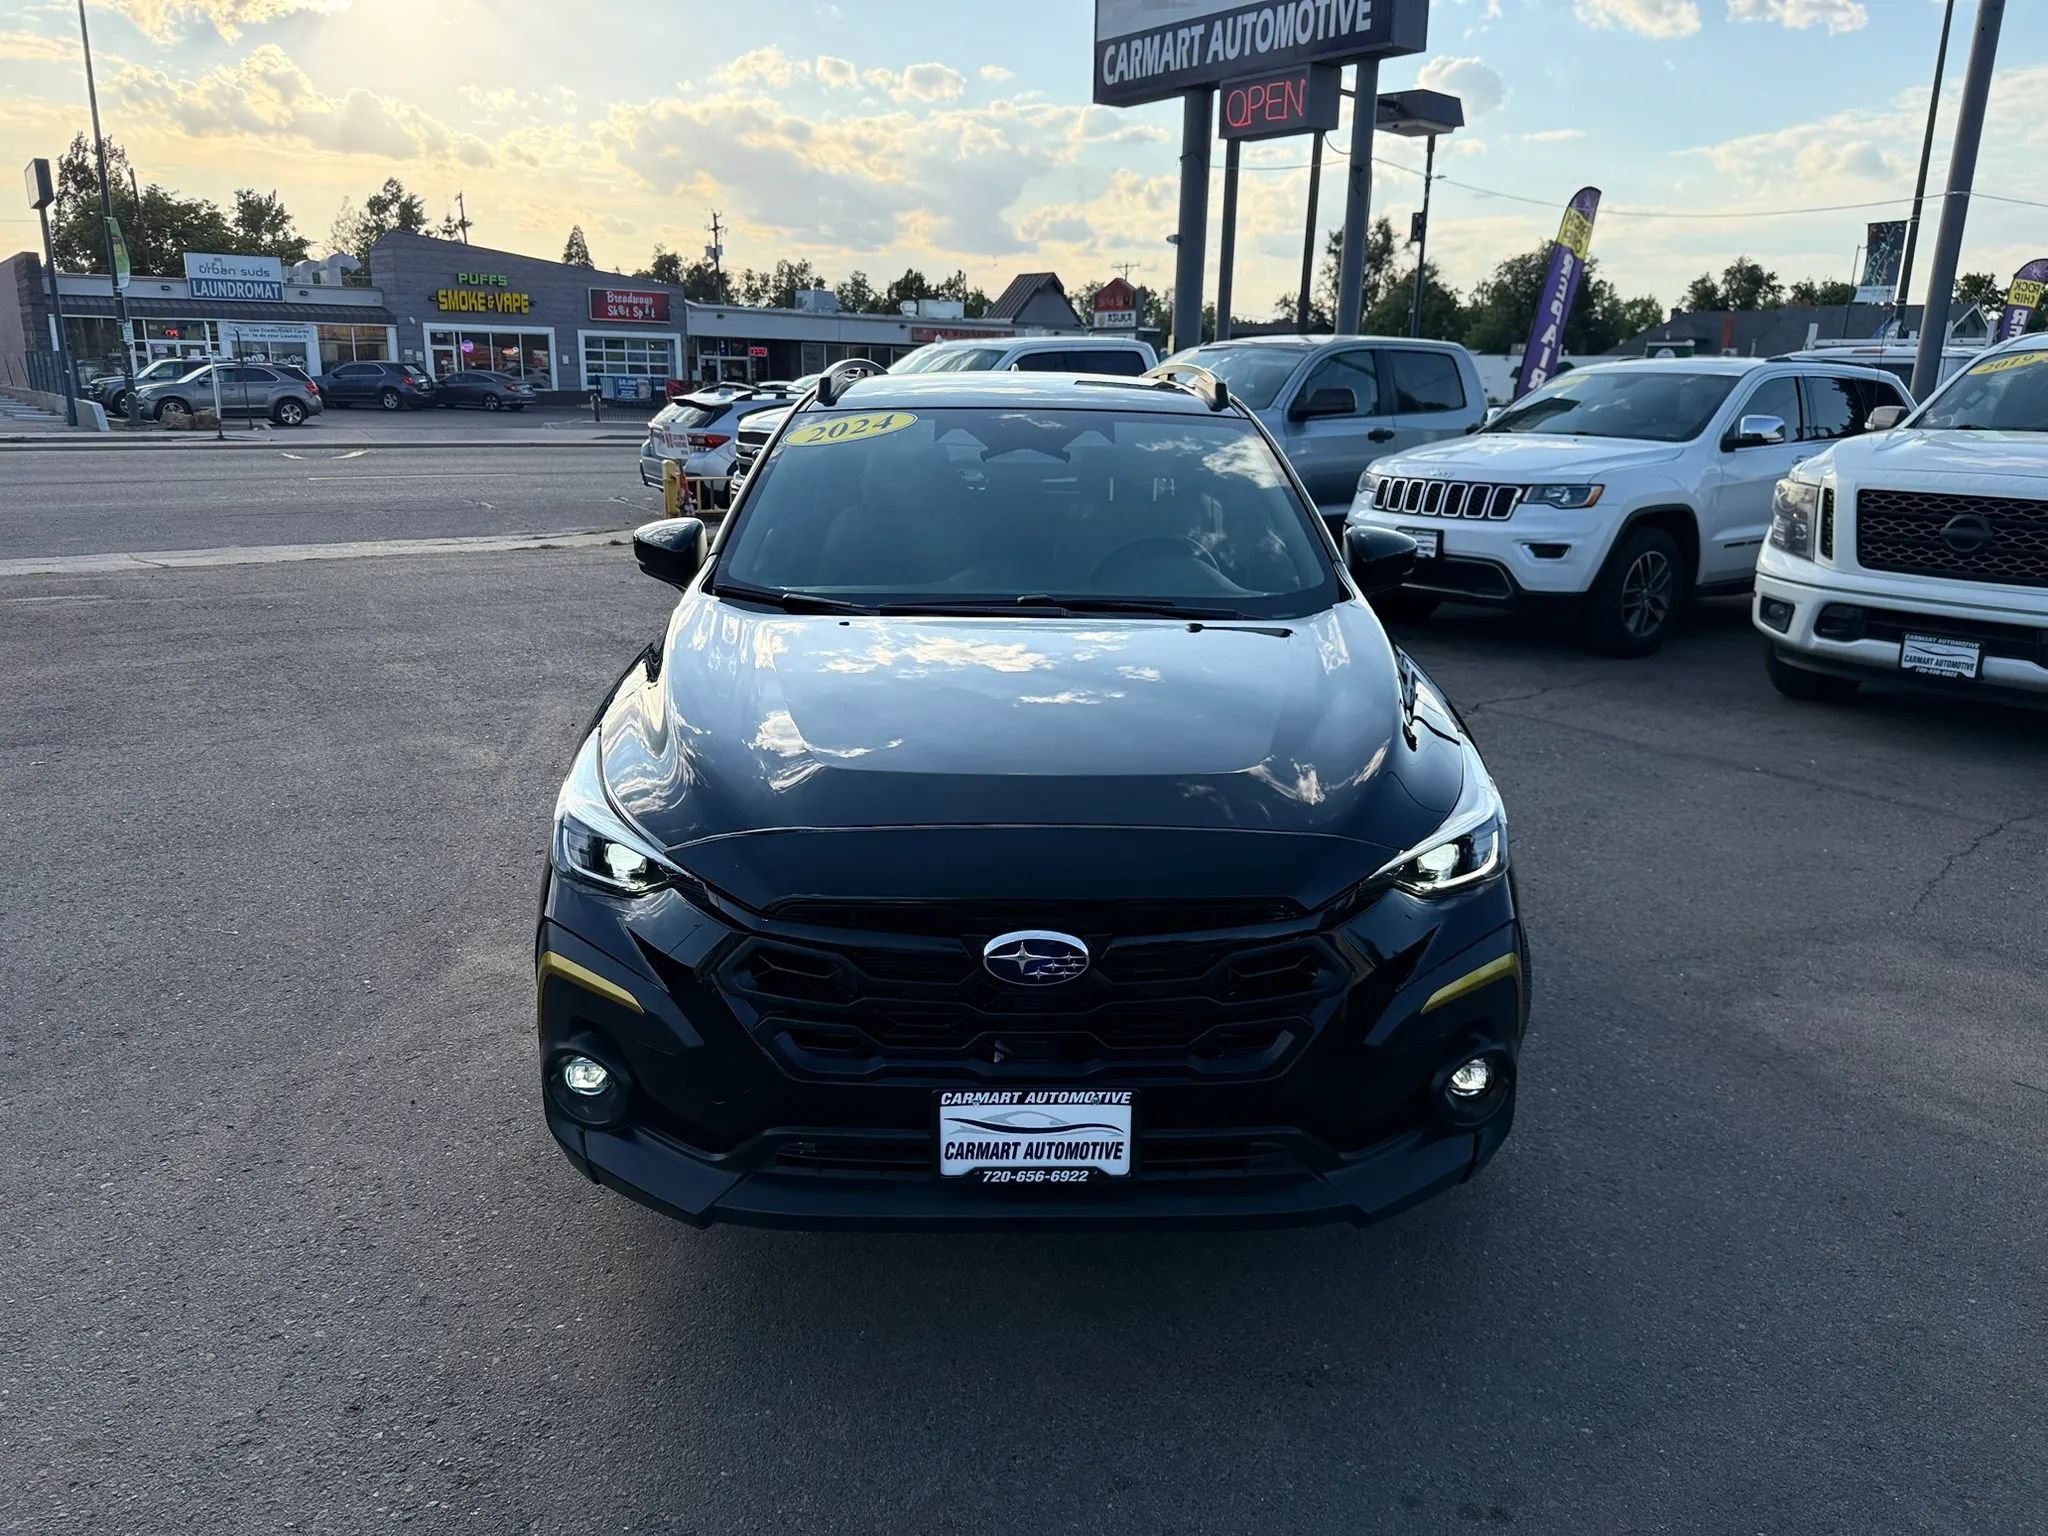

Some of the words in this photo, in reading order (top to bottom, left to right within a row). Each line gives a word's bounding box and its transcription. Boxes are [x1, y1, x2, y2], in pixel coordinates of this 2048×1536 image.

[1102, 24, 1205, 86] CARMART
[1205, 0, 1372, 64] AUTOMOTIVE
[1226, 78, 1306, 128] OPEN
[240, 267, 271, 278] suds
[457, 272, 508, 287] PUFFS
[192, 280, 280, 300] LAUNDROMAT
[438, 288, 487, 313] SMOKE
[495, 292, 530, 314] VAPE
[805, 413, 895, 444] 2024
[1903, 654, 1935, 666] CARMART
[1934, 658, 1975, 672] AUTOMOTIVE
[941, 1091, 1022, 1105] CARMART
[1024, 1091, 1132, 1105] AUTOMOTIVE
[944, 1141, 1021, 1161] CARMART
[1023, 1141, 1124, 1161] AUTOMOTIVE
[982, 1170, 1089, 1183] 720-656-6922
